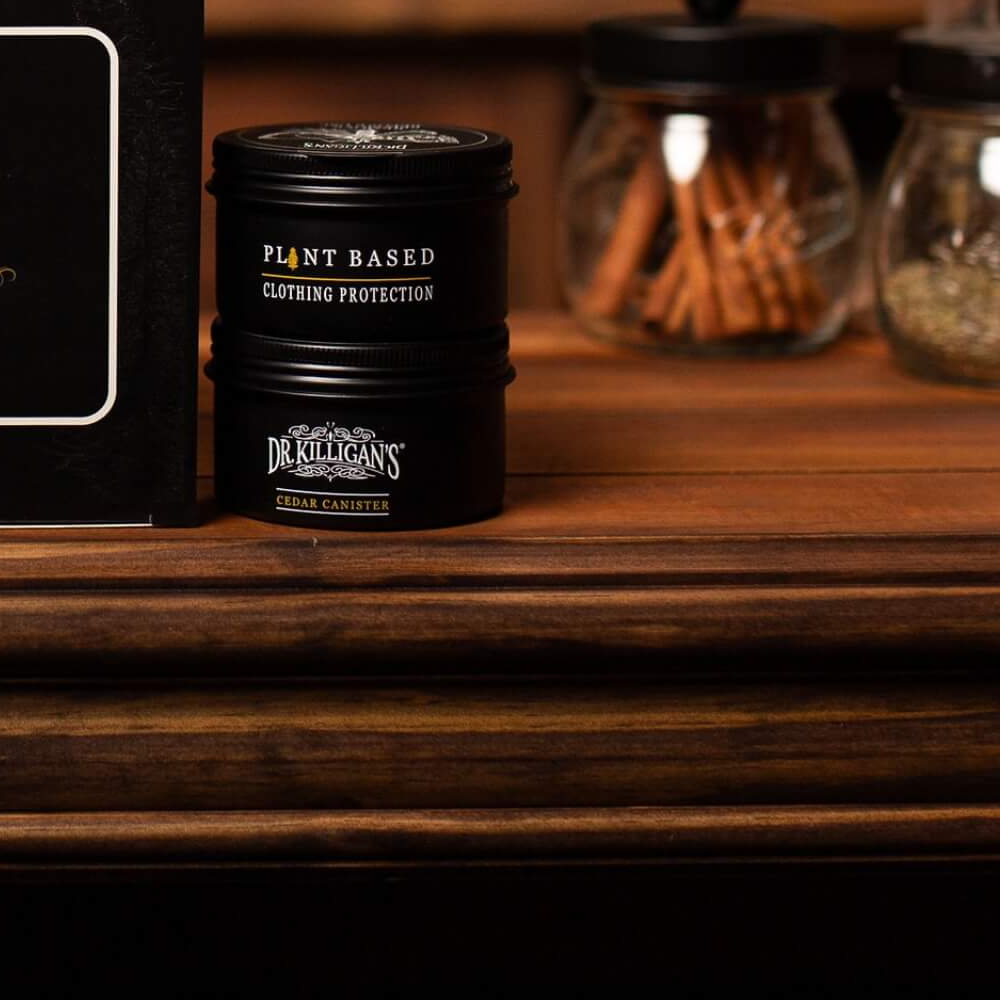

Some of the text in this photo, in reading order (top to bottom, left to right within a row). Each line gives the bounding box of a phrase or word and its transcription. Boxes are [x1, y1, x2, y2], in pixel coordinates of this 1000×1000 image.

[349, 247, 435, 268] BASED
[263, 282, 434, 303] CLOTHING PROTECTION
[276, 495, 390, 511] CEDAR CANISTER
